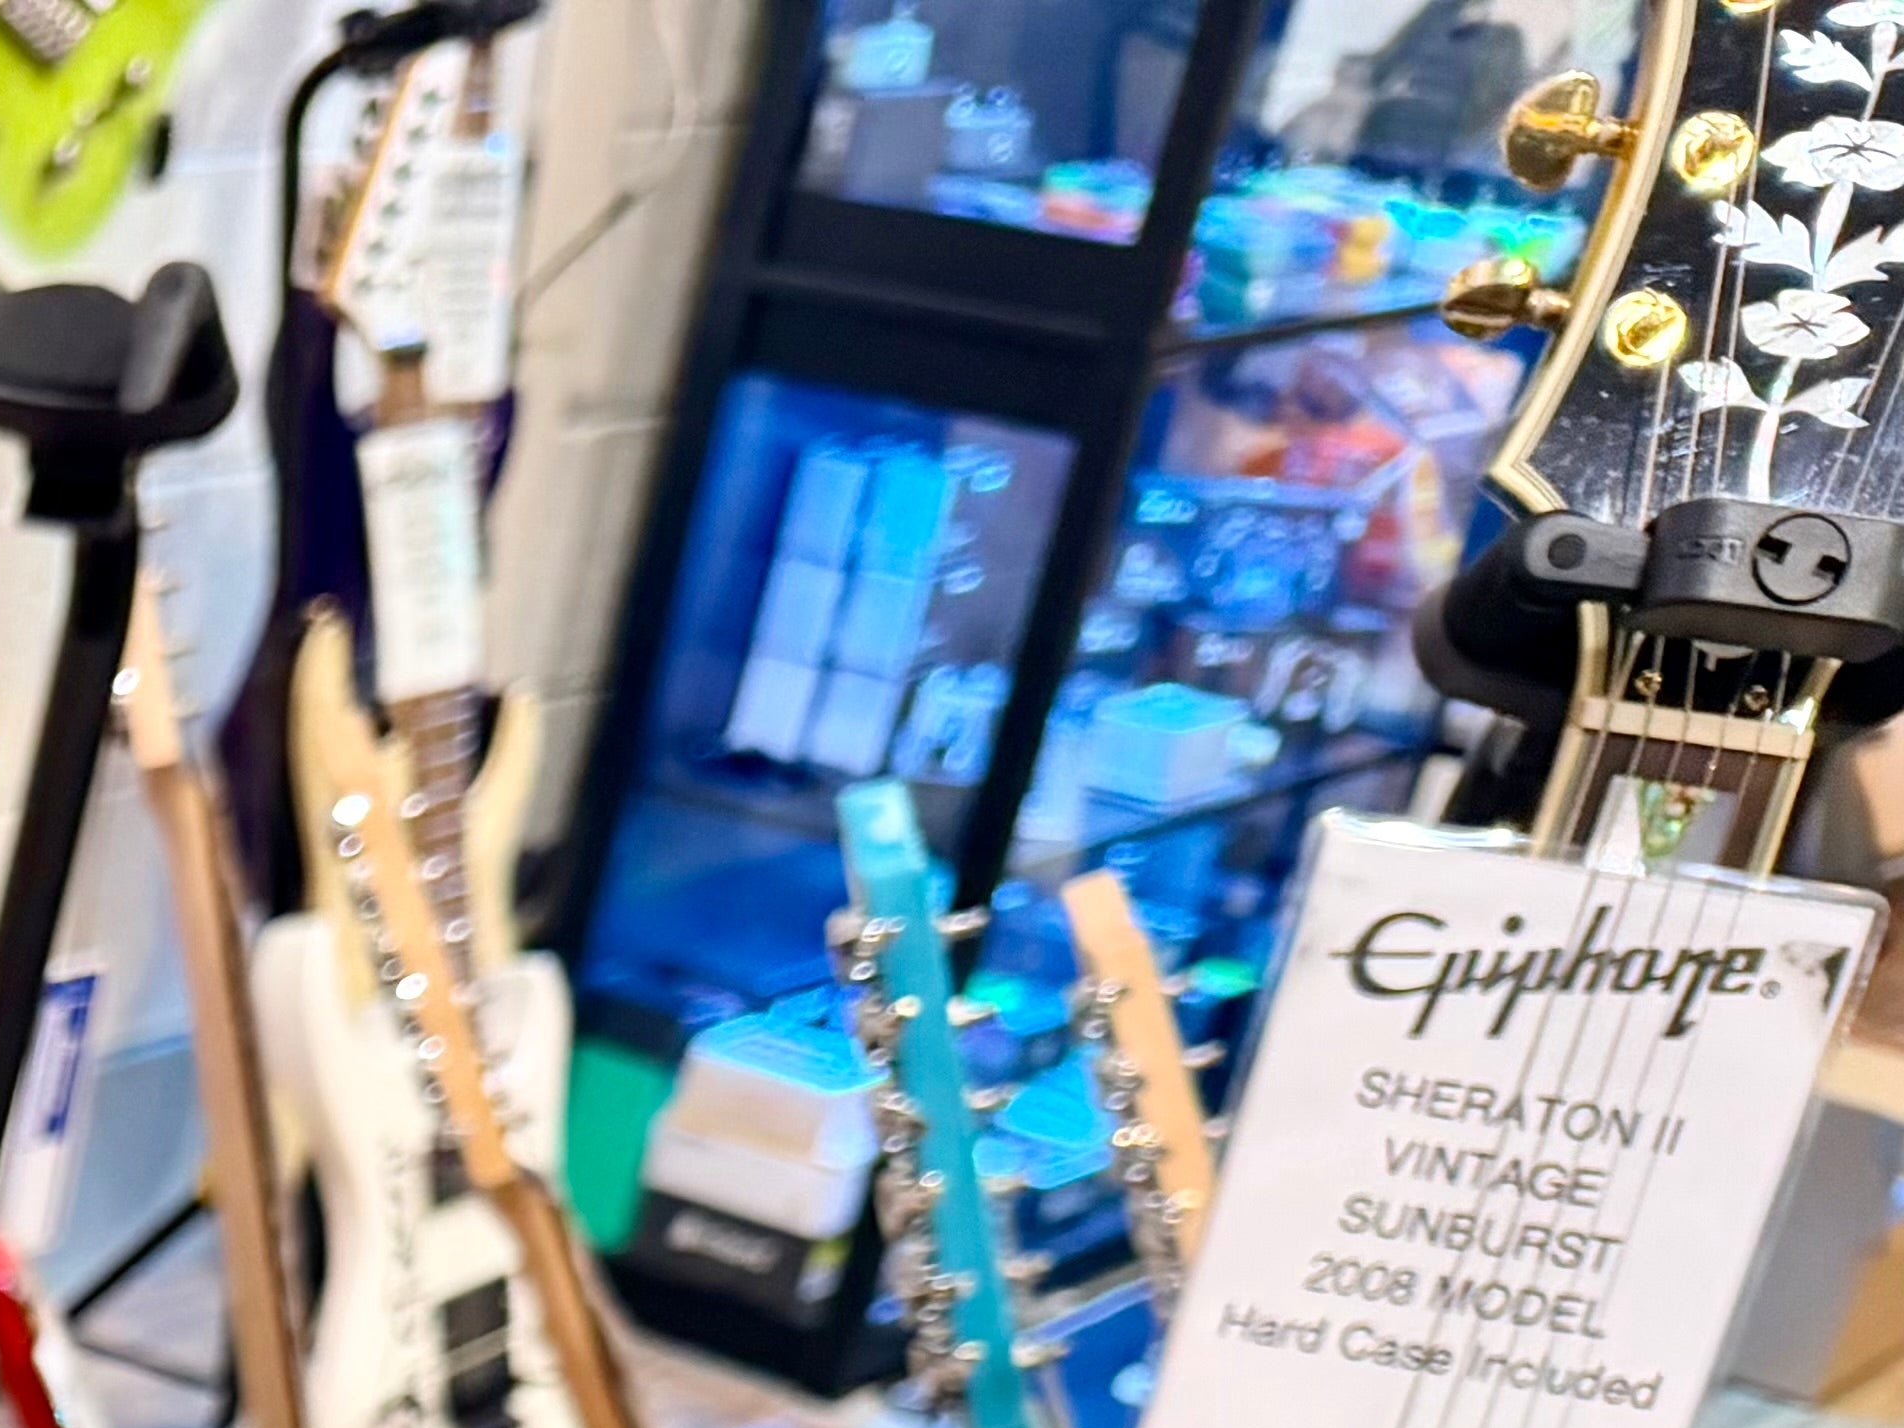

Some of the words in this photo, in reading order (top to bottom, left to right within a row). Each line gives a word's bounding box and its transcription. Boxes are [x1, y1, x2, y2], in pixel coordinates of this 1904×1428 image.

[1355, 1066, 1641, 1148] SHERATON
[1652, 1115, 1686, 1156] II
[1385, 1137, 1610, 1208] VINTAGE
[1337, 1192, 1625, 1274] SUNBURST
[1302, 1252, 1416, 1306] 2008
[1427, 1276, 1606, 1340] MODEL
[1218, 1303, 1328, 1354] Hard
[1338, 1320, 1452, 1376] Case
[1468, 1345, 1663, 1411] Included
